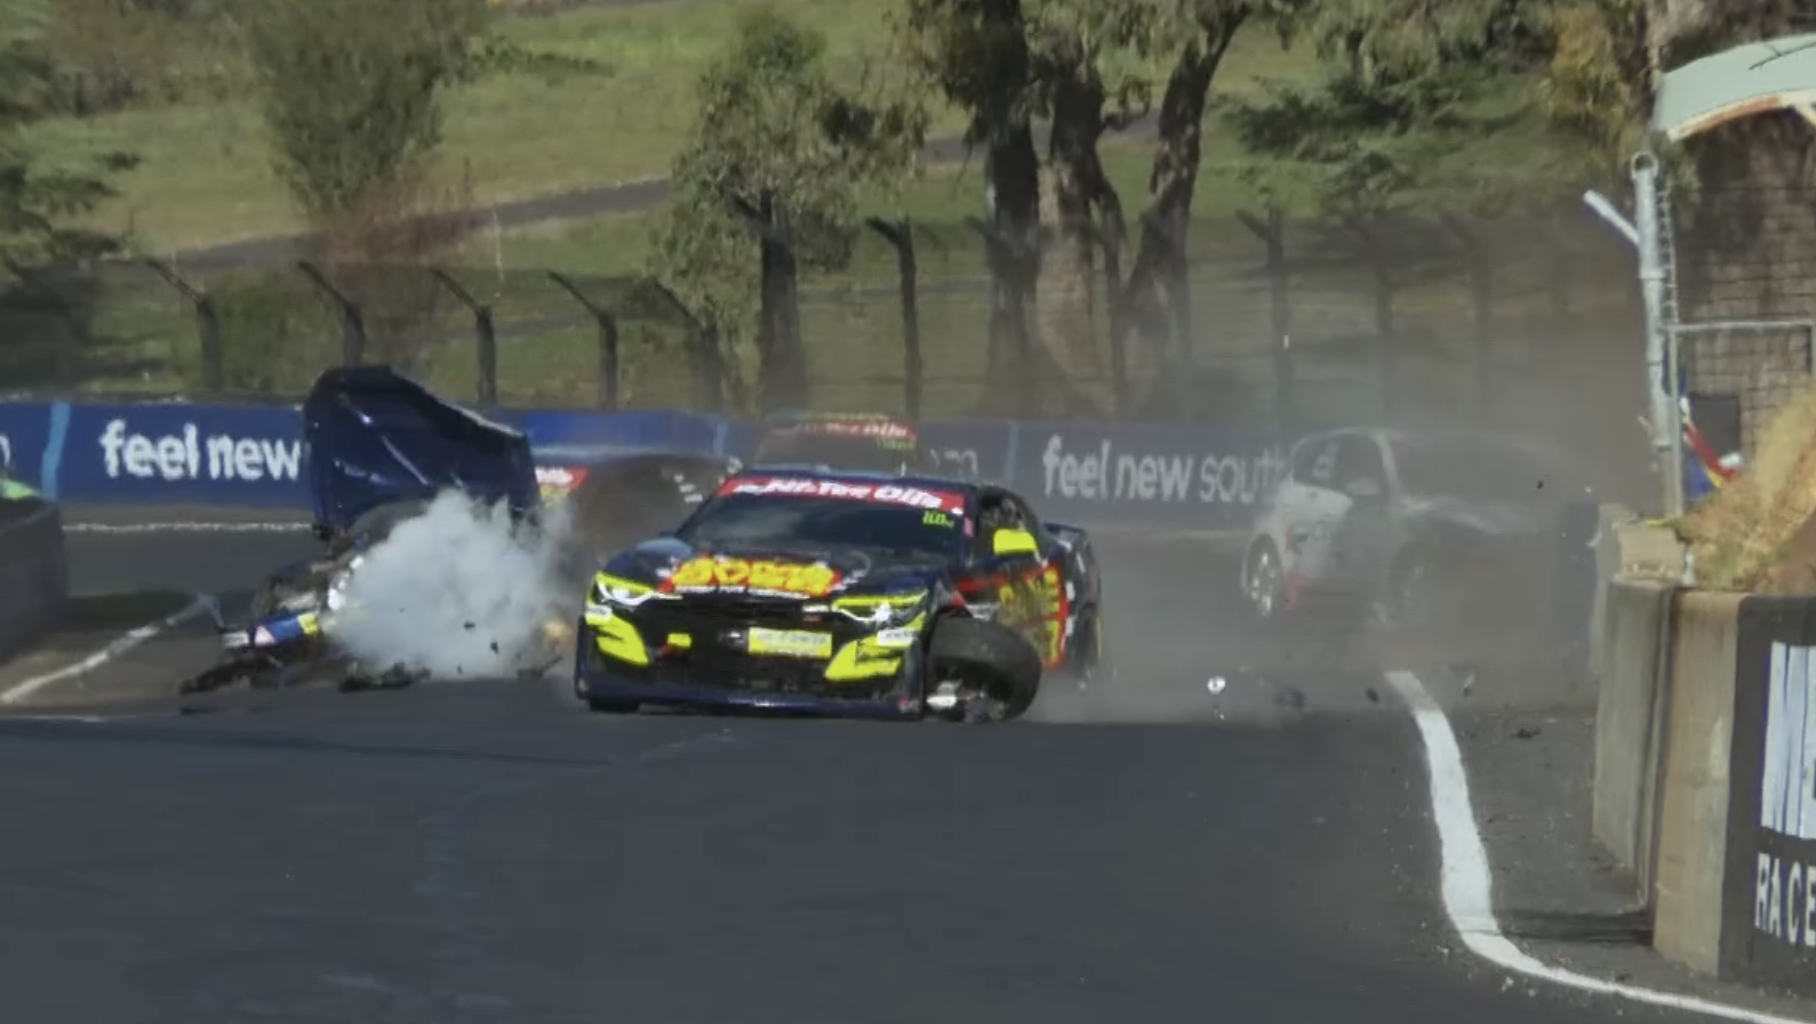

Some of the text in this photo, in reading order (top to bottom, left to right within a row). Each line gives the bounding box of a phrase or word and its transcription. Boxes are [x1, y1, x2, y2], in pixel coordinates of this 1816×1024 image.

[99, 417, 300, 482] feel new
[1042, 434, 1111, 499] feel
[1115, 453, 1194, 502] new
